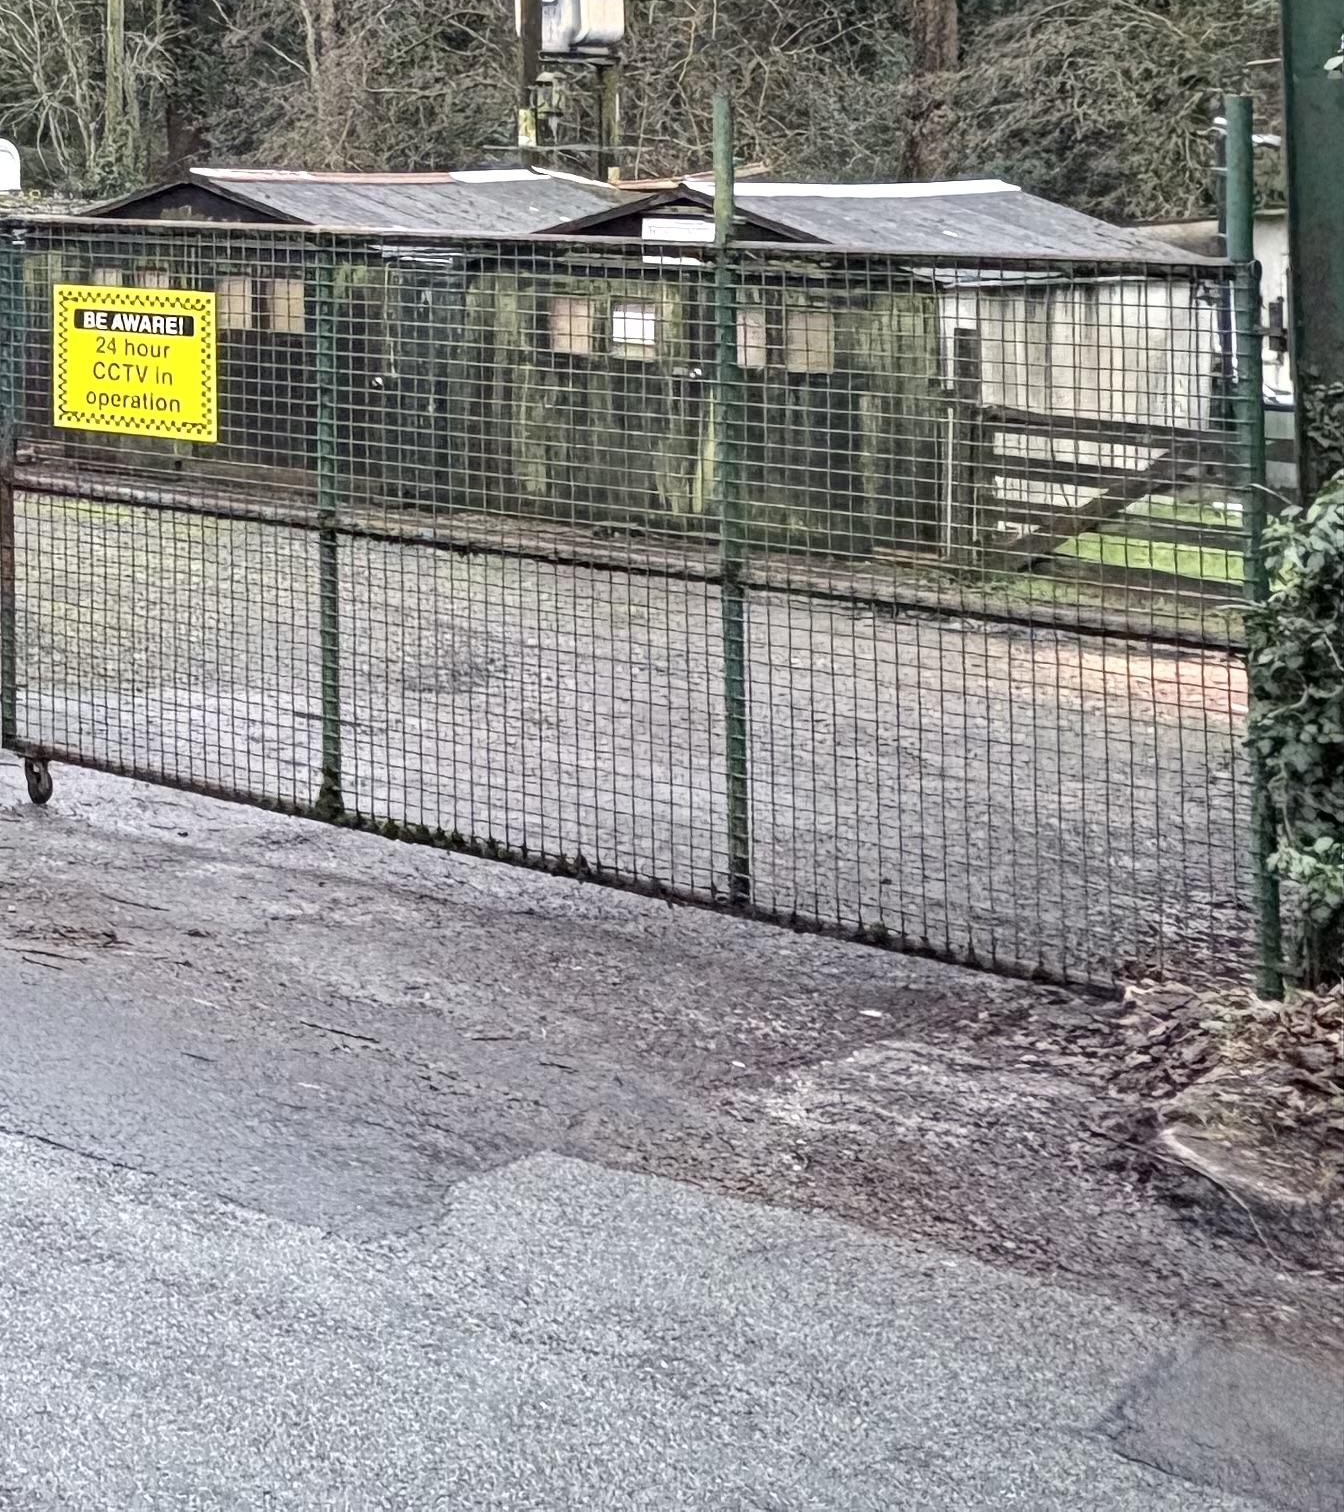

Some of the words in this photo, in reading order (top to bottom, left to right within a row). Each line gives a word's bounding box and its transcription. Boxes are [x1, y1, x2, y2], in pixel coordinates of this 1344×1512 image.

[83, 311, 108, 330] BE
[111, 313, 184, 335] AWARE!
[95, 336, 116, 354] 24
[124, 338, 171, 359] hour
[93, 361, 148, 383] CCTV
[155, 366, 173, 386] in
[86, 391, 181, 413] operation
